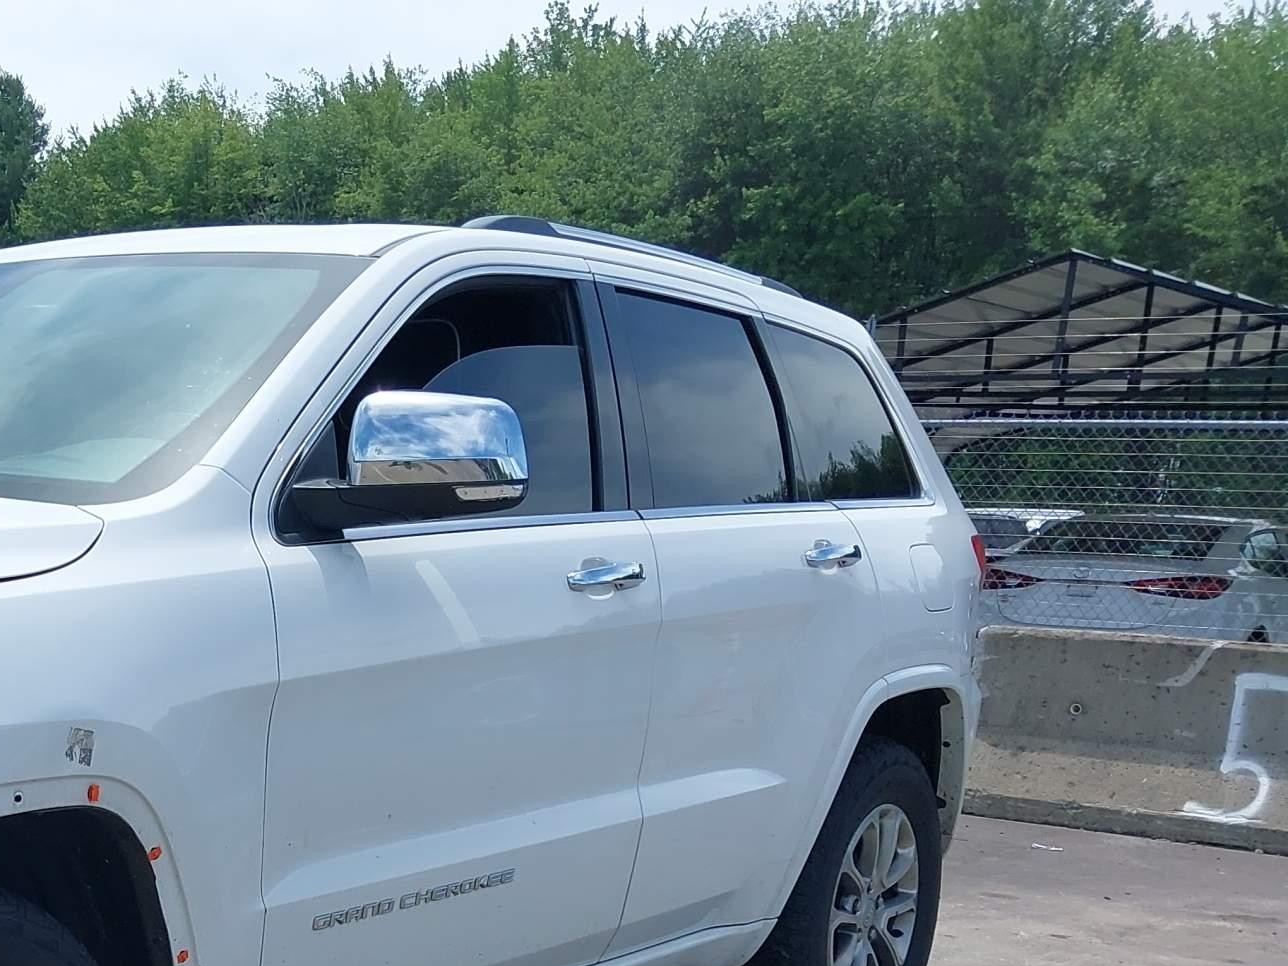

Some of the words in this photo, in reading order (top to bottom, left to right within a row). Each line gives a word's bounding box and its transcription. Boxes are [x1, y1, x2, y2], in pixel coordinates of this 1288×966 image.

[1182, 672, 1288, 824] 5
[312, 898, 395, 931] GRAND
[399, 867, 516, 910] CHEROKEE
